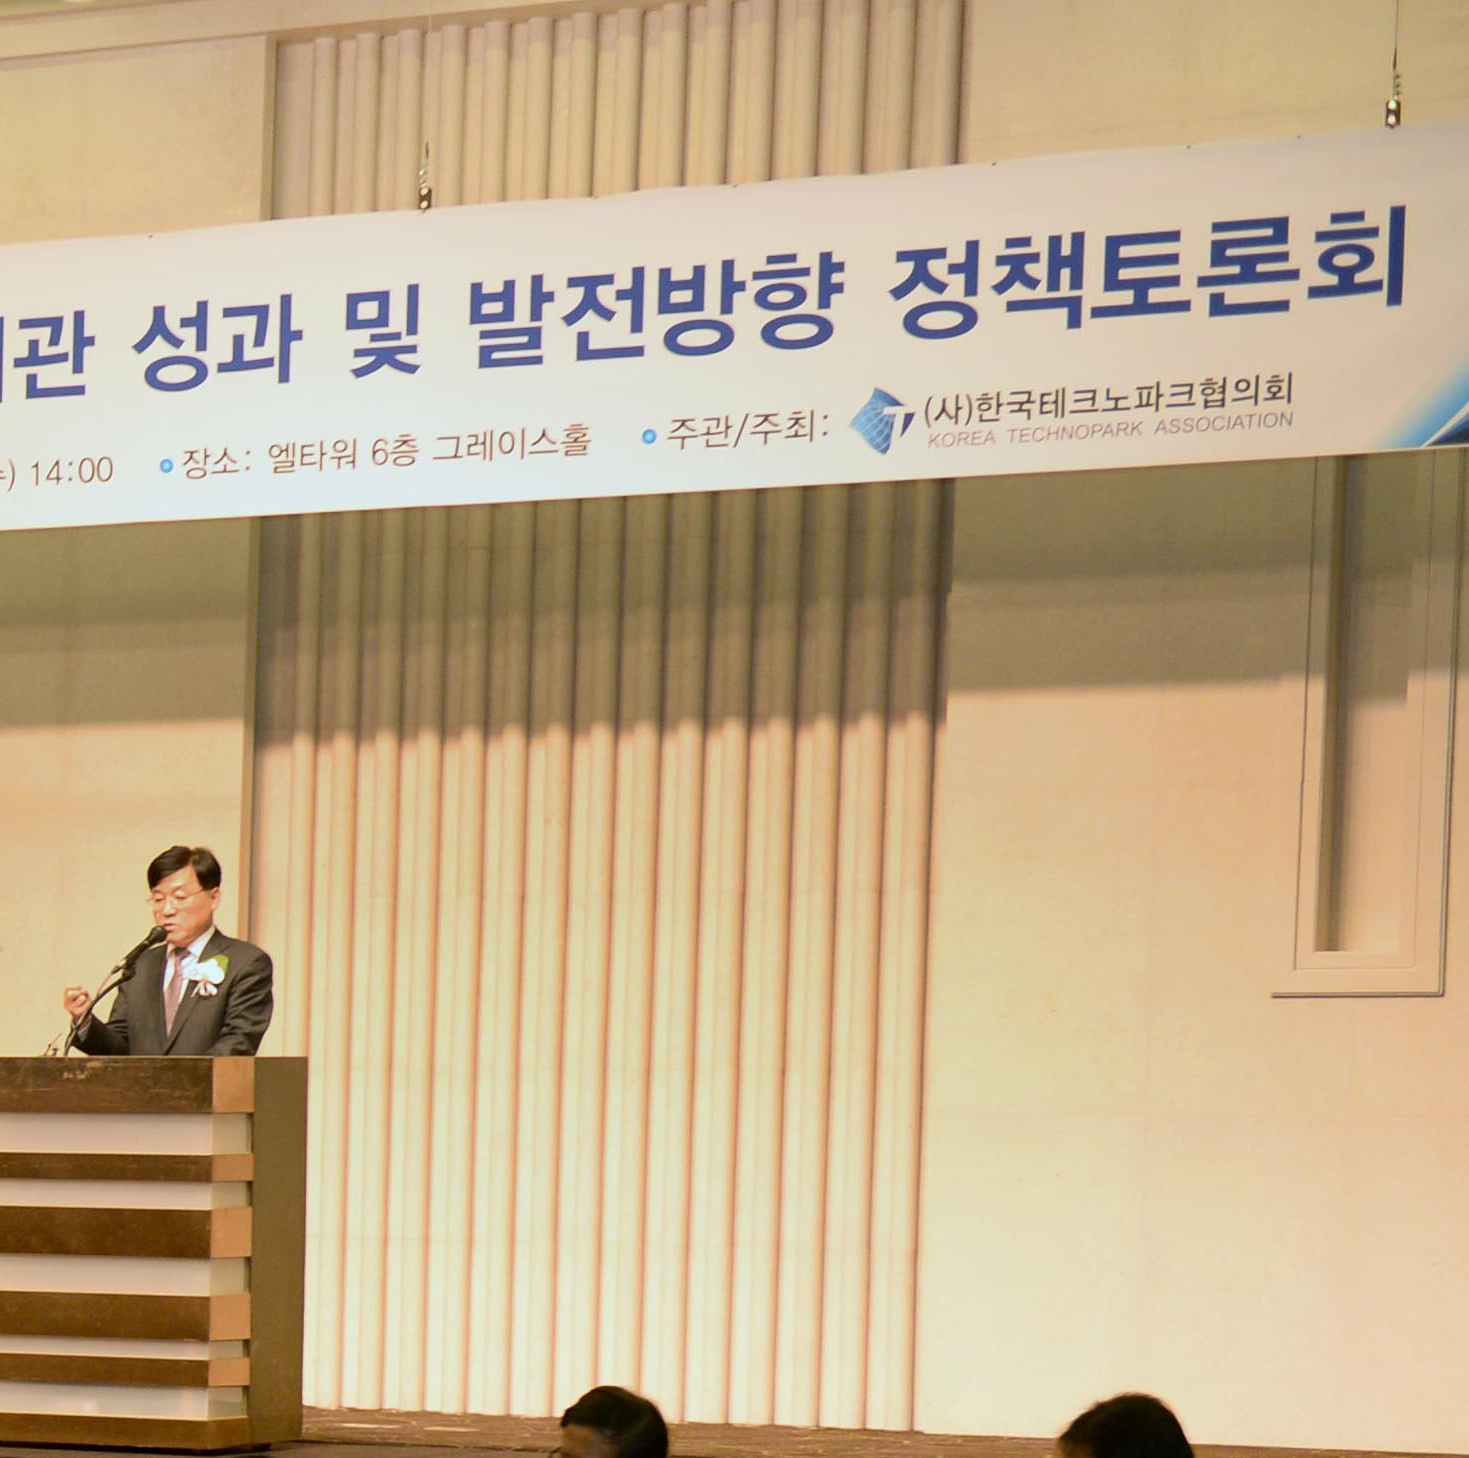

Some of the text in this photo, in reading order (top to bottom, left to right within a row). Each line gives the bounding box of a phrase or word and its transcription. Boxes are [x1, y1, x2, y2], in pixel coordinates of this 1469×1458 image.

[131, 293, 304, 393] 성과
[345, 282, 421, 379] 및
[468, 250, 846, 370] 발전방향
[888, 204, 1407, 340] 정책토론회
[666, 372, 1293, 450] 주관/주최: (사)한국테크노파크협의회
[928, 411, 1294, 448] KOREA TECHNOPARK ASSOCIATION
[31, 456, 114, 486] 14:00
[182, 423, 592, 480] 장소: 엘타워 6층 그레이스홀
